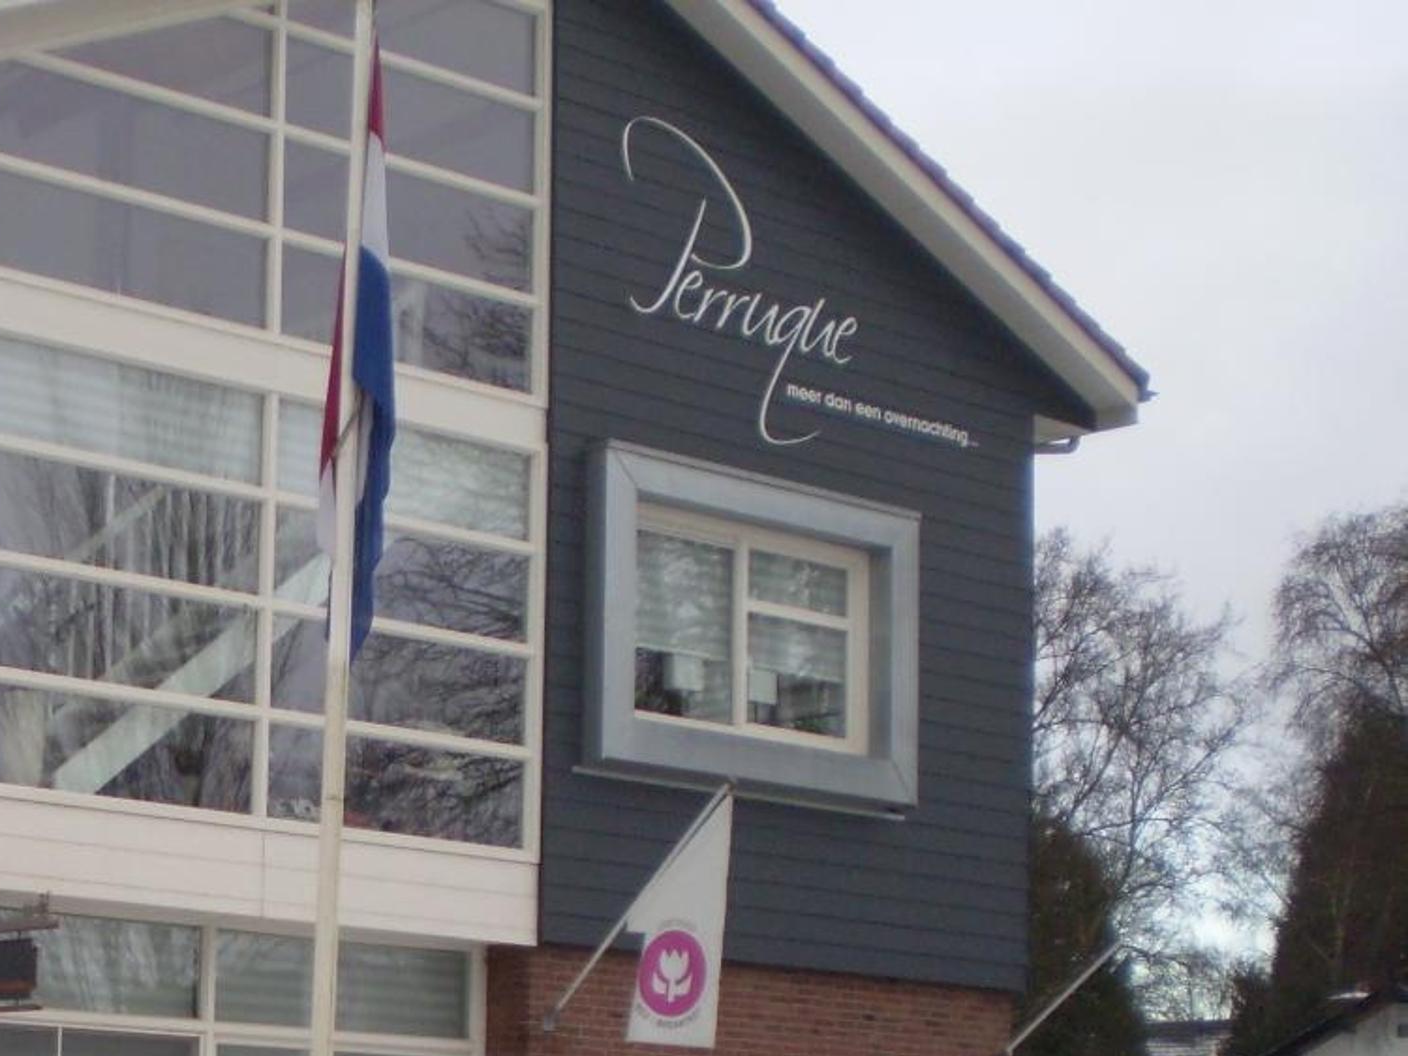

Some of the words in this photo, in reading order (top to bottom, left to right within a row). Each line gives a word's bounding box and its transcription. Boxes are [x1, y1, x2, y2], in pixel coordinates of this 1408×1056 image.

[622, 116, 858, 445] Perruque
[786, 384, 822, 403] meer
[824, 392, 852, 413] dan
[855, 401, 882, 421] een
